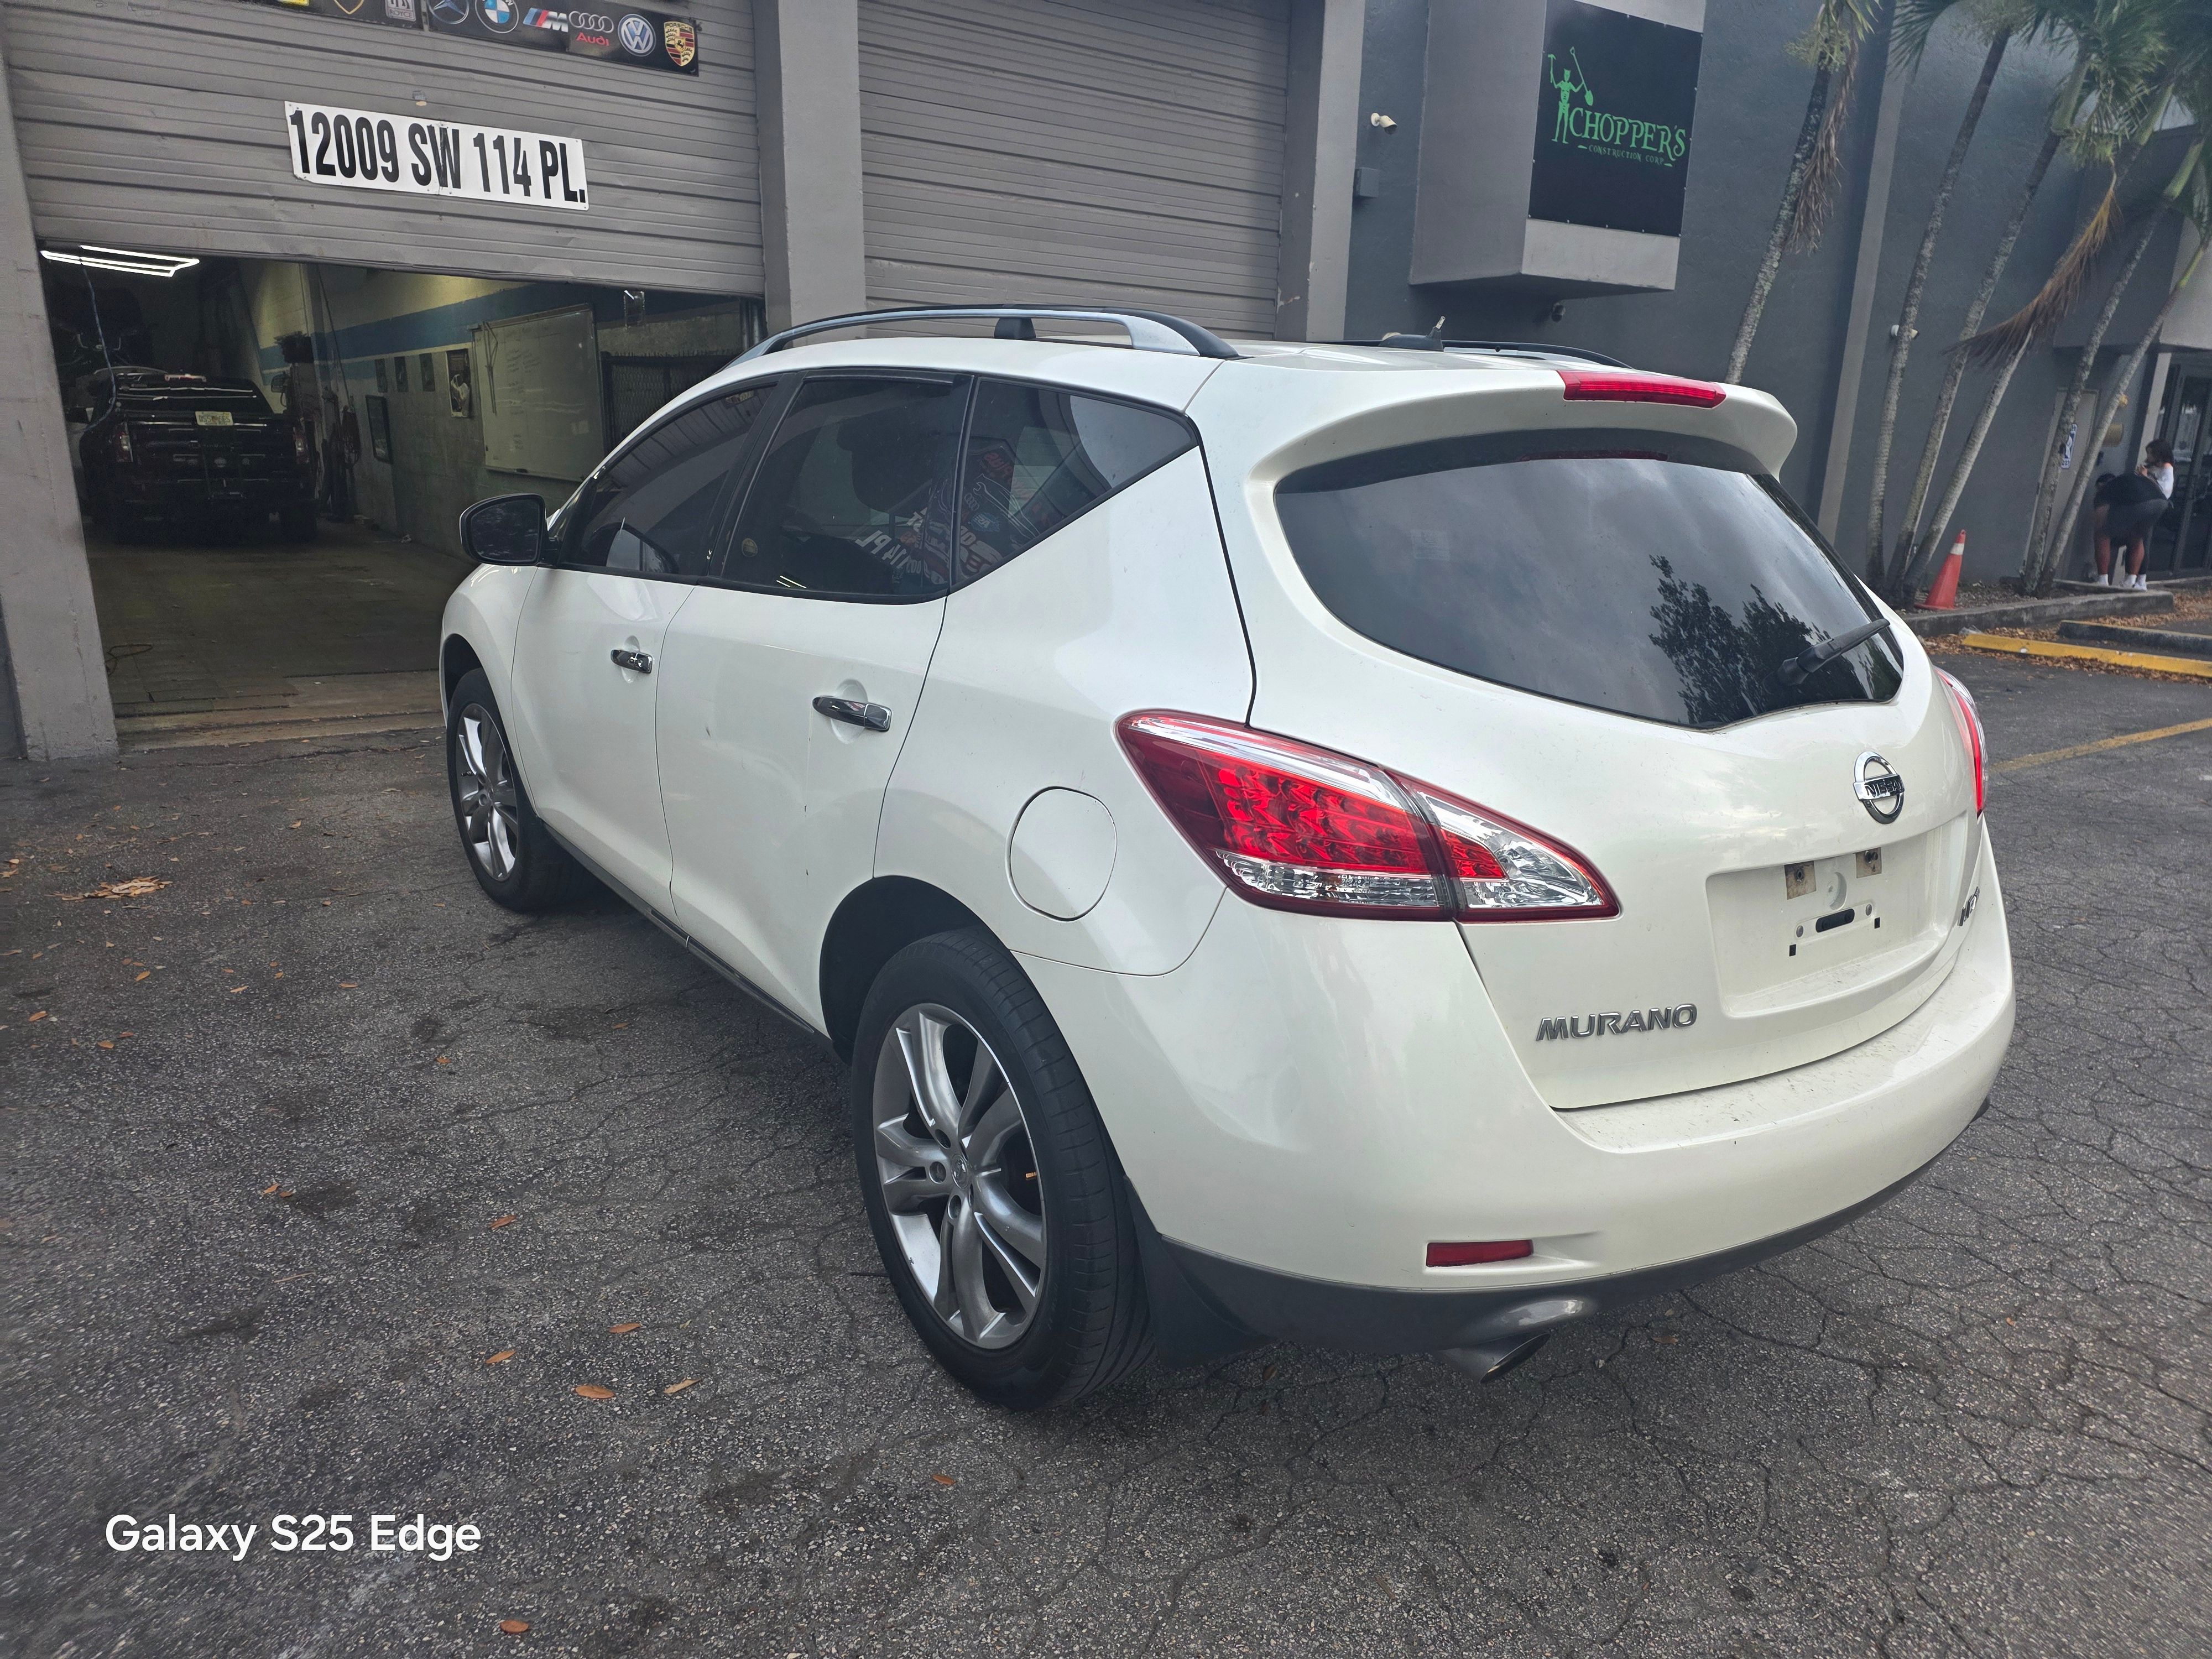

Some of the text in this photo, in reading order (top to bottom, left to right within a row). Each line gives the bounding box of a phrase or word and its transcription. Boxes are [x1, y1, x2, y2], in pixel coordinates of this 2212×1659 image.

[576, 32, 609, 46] Audi
[1569, 107, 1686, 161] CHOPPER'S
[289, 110, 586, 204] 12009 SW 114 PL.
[1588, 144, 1642, 163] CONSTRUCTION
[1864, 779, 1903, 797] NISSAN
[1536, 1003, 1698, 1042] MURANO
